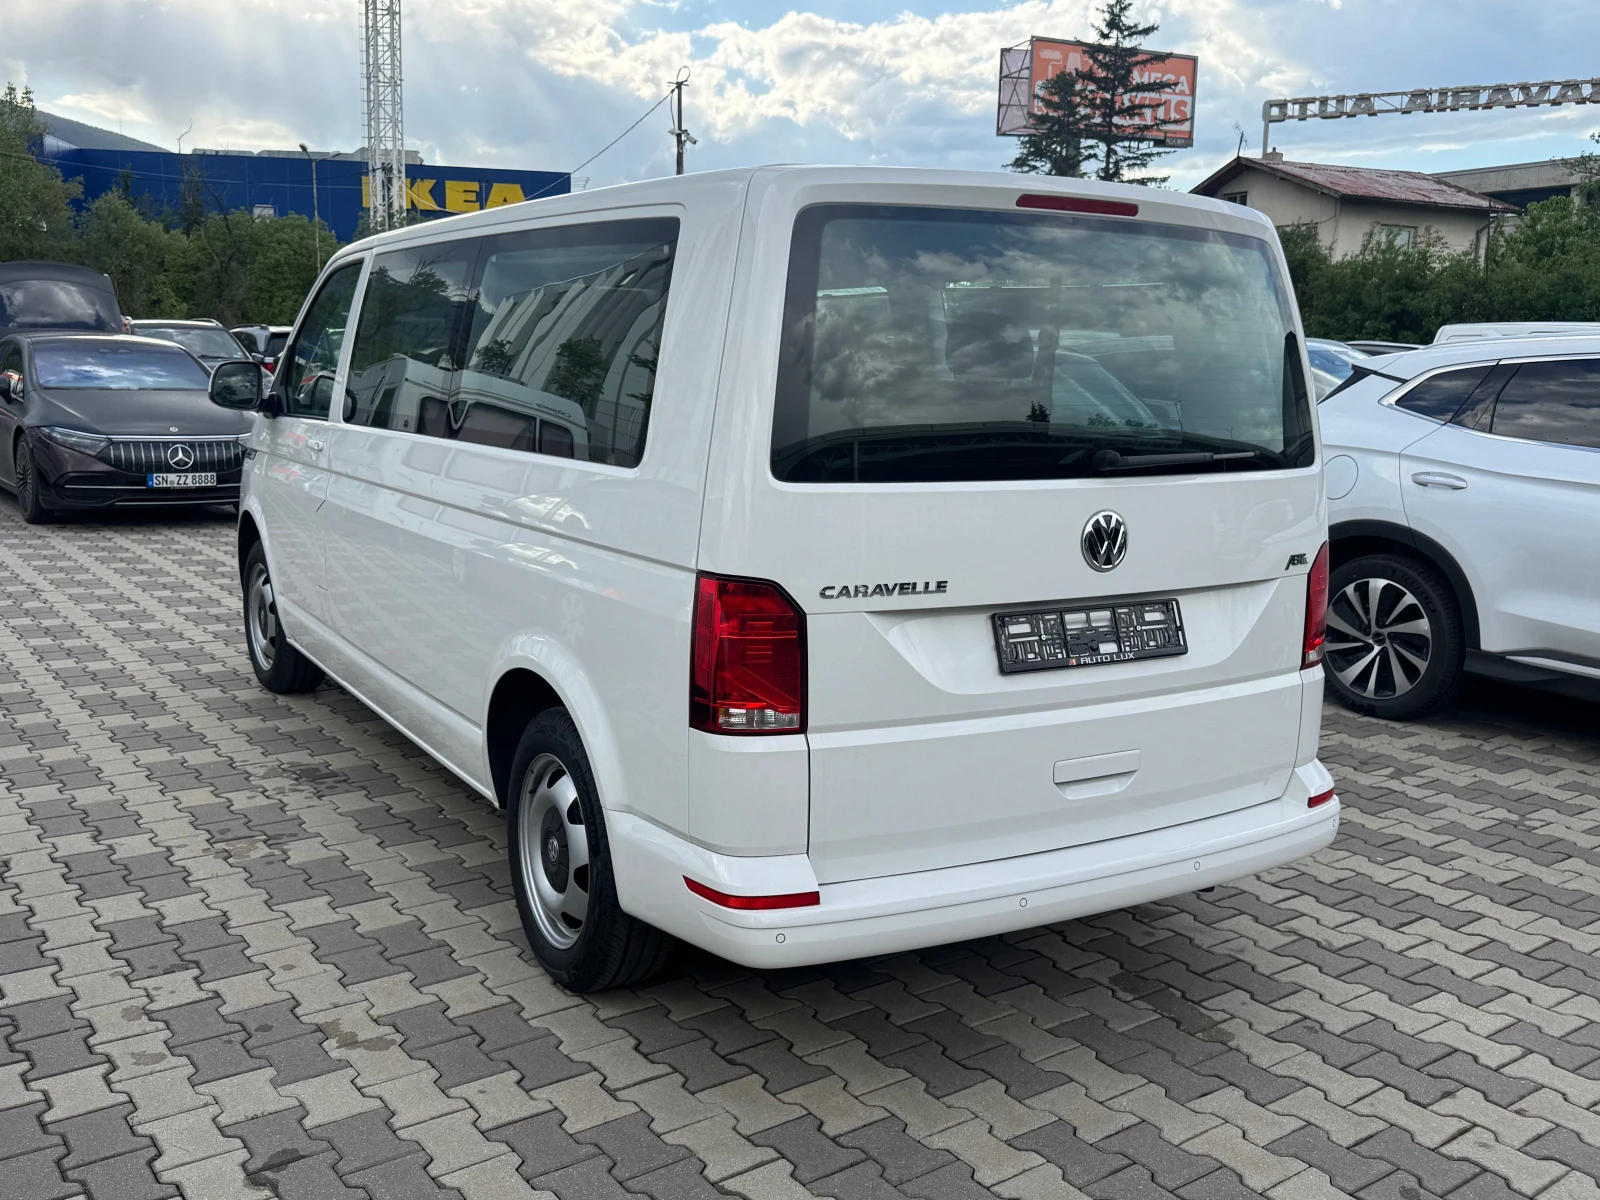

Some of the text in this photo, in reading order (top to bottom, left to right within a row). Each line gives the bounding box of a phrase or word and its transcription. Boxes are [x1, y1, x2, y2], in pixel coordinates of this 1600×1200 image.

[155, 474, 216, 486] SN ZZ 8888
[819, 580, 948, 599] CARAVELLE
[1080, 655, 1110, 665] AUTO
[1113, 652, 1135, 661] LUX
